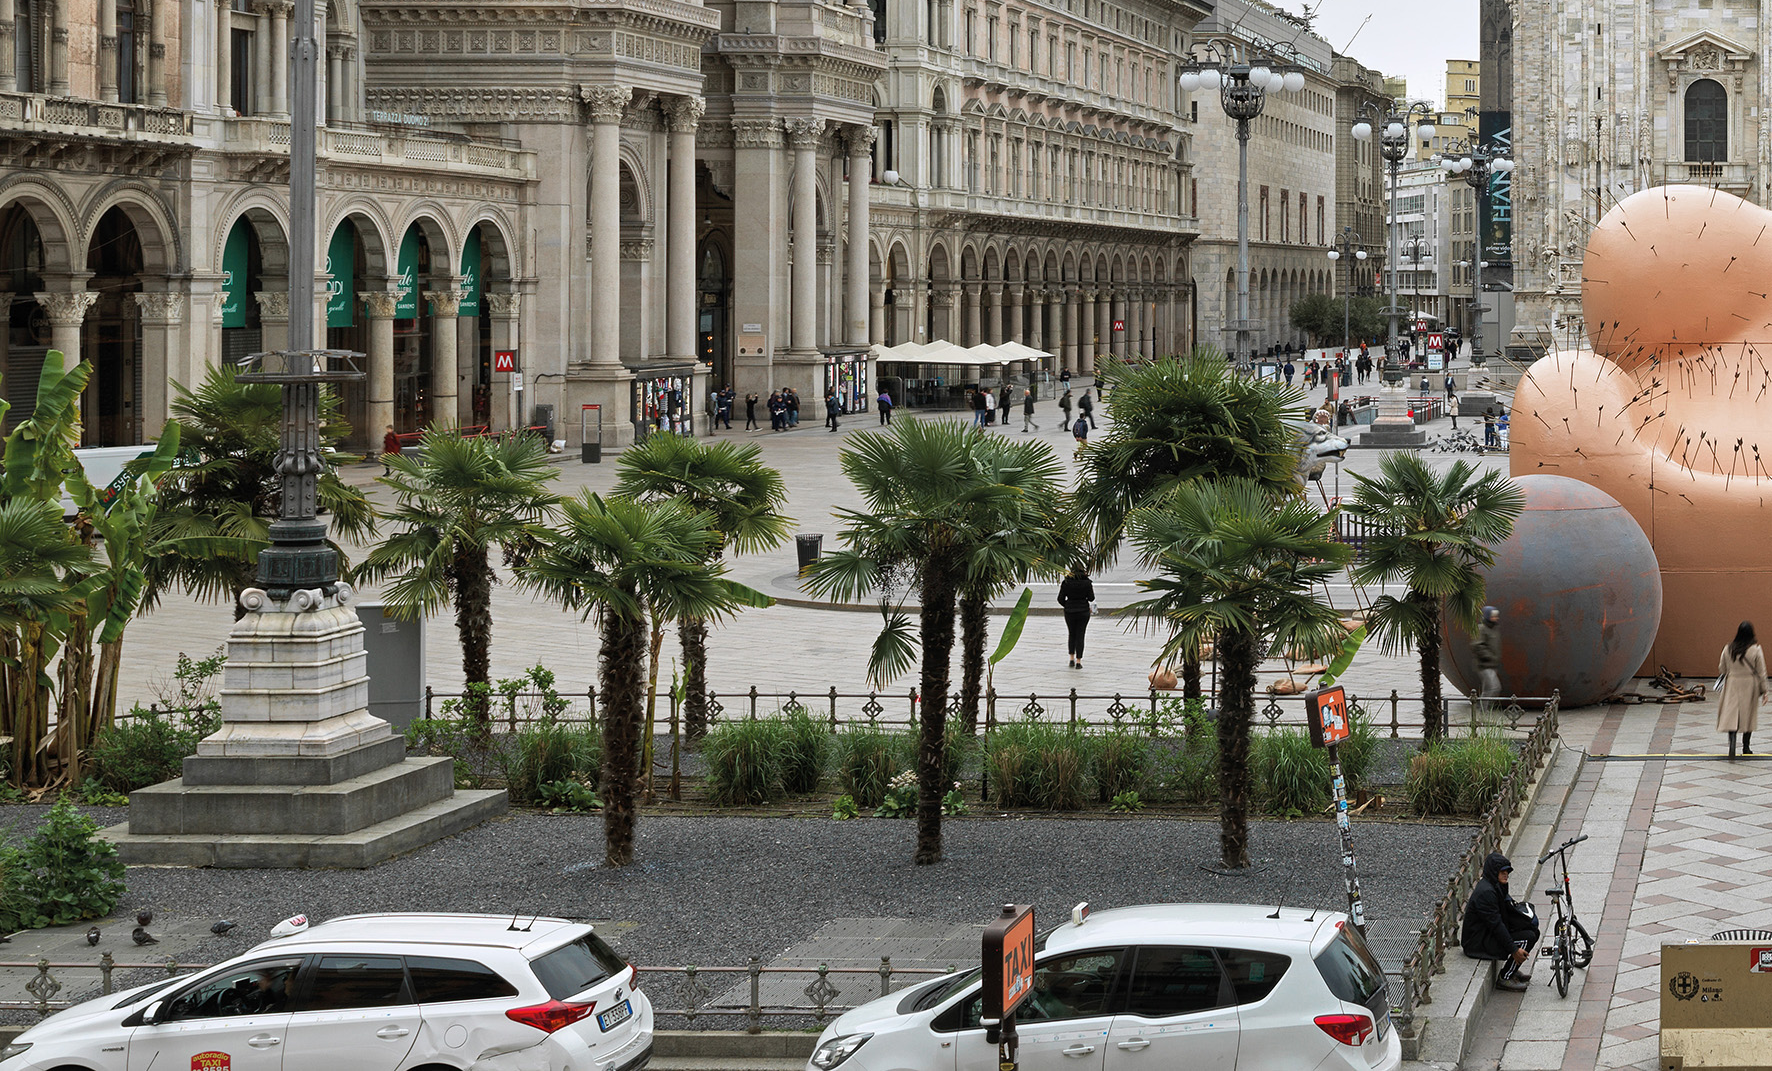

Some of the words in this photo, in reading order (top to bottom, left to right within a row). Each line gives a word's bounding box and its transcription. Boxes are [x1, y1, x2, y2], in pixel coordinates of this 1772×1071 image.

[373, 111, 402, 123] TERRAZZA
[403, 114, 423, 126] DUOMO
[1114, 322, 1124, 330] M
[1417, 322, 1427, 330] M
[1428, 335, 1442, 347] M
[497, 355, 513, 368] M
[1005, 933, 1031, 988] TAXI
[193, 1052, 229, 1062] autoradio
[200, 1059, 221, 1067] TAXI
